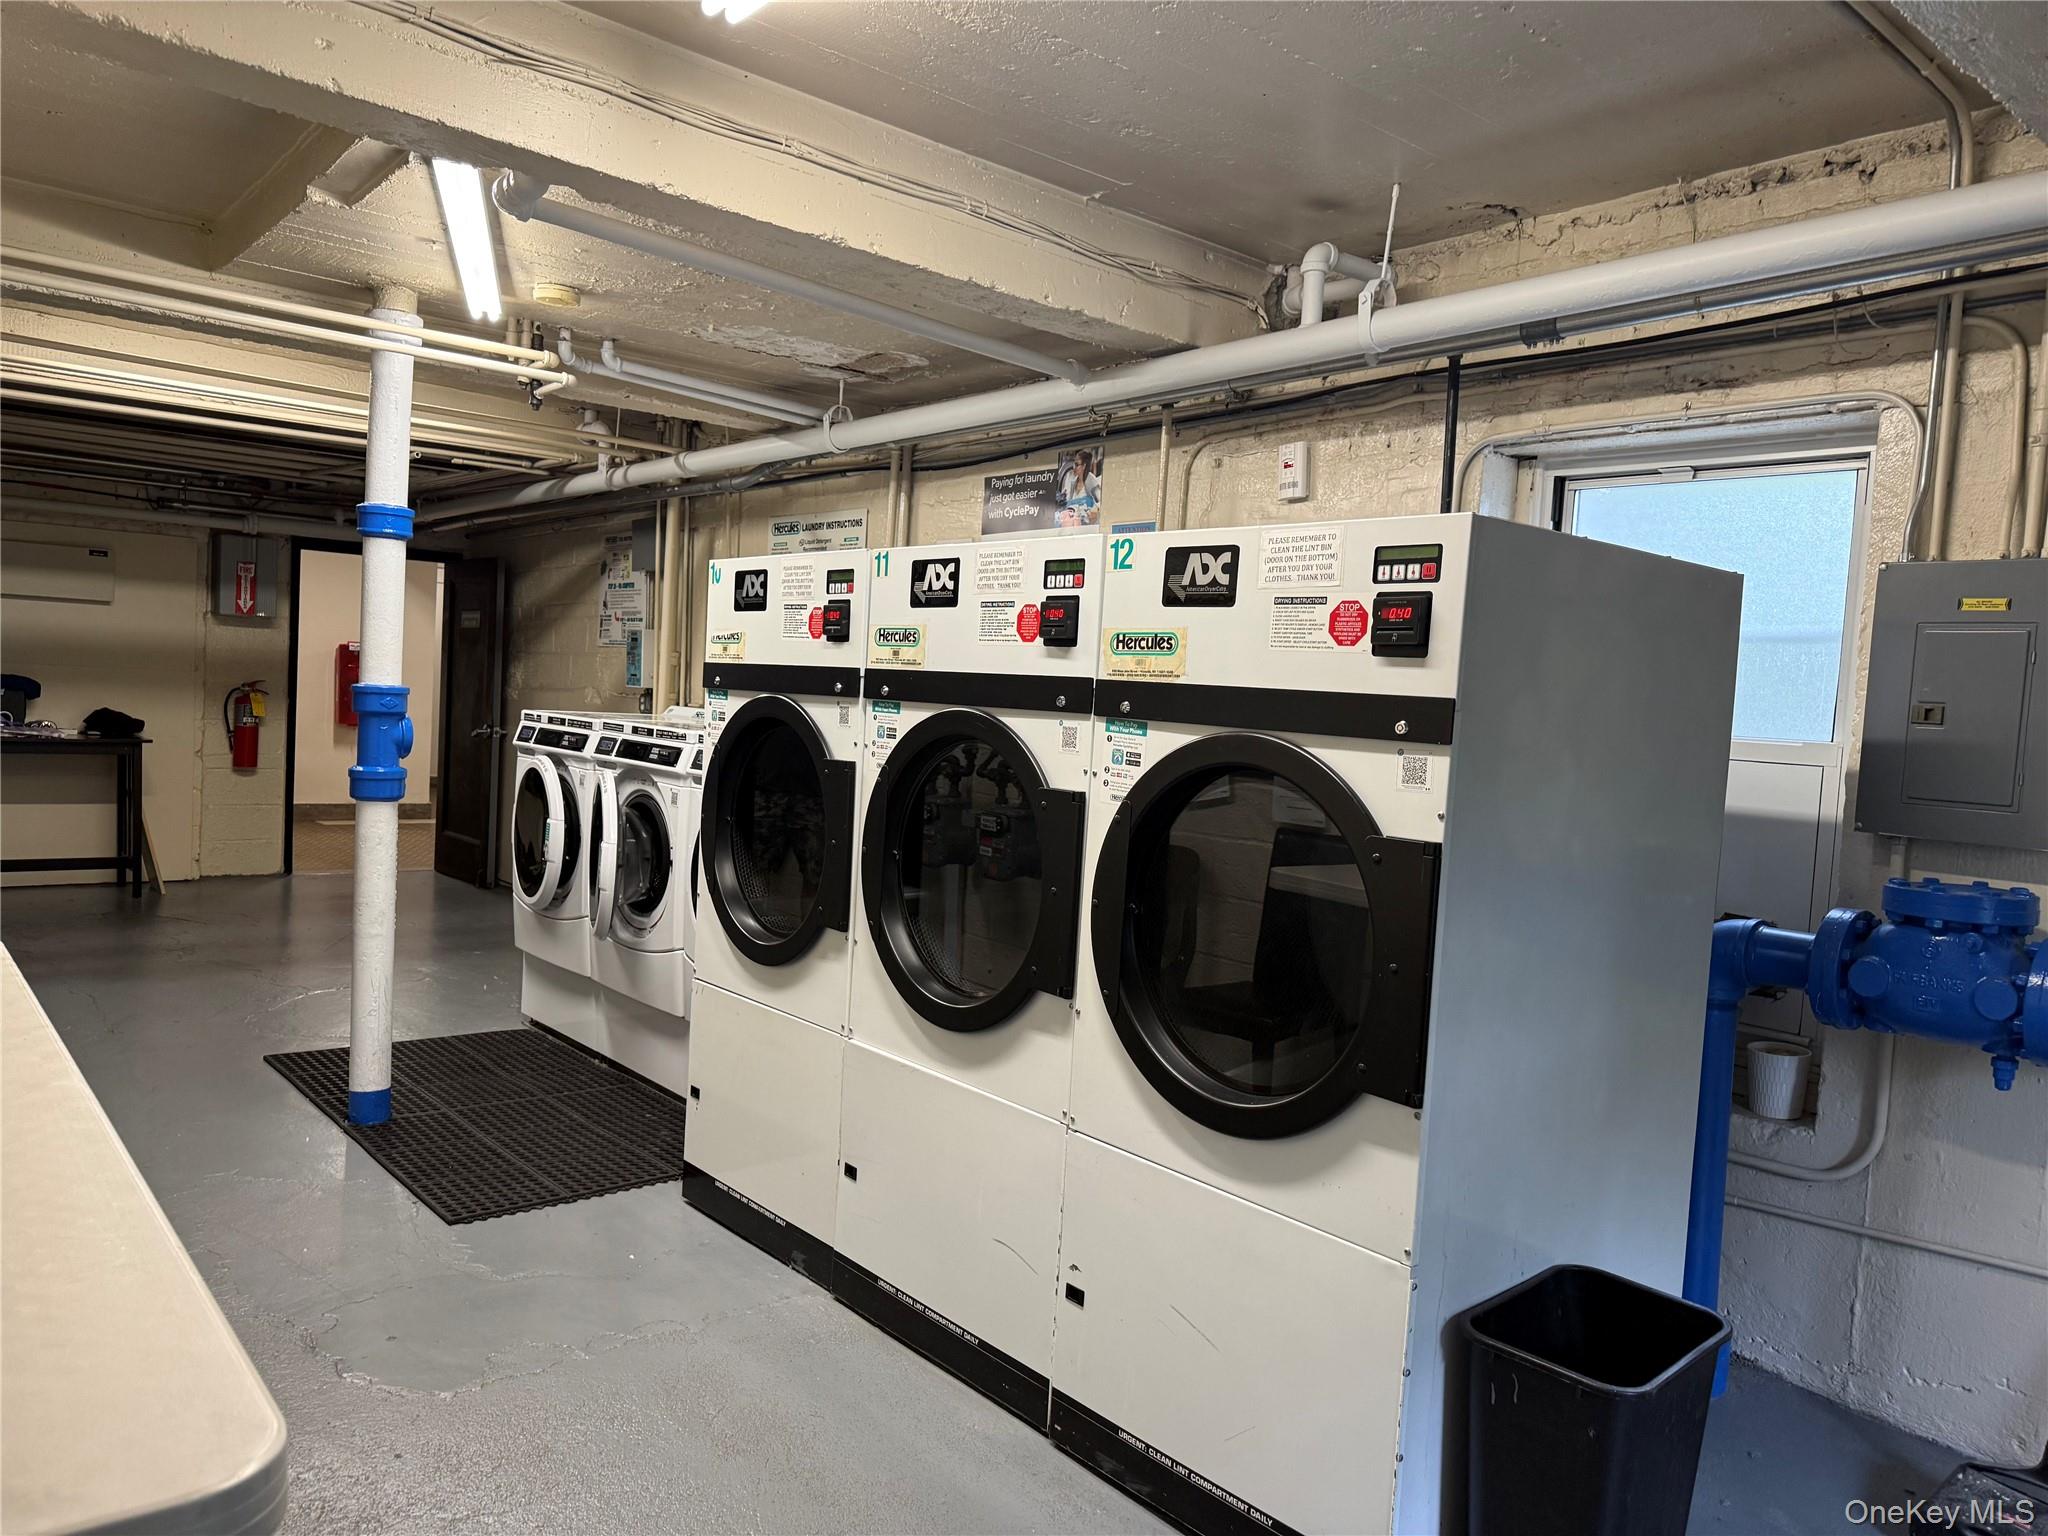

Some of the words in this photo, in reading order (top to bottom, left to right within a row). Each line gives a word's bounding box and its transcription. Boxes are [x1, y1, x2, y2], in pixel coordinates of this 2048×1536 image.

[992, 477, 1014, 490] Paying
[1014, 474, 1024, 484] for
[1025, 471, 1055, 483] laundry
[989, 494, 1002, 506] just
[1003, 492, 1014, 503] got
[1016, 488, 1038, 500] easier
[988, 508, 1003, 519] with
[1004, 505, 1039, 519] CyclePay
[774, 522, 799, 533] Hercules
[802, 522, 824, 532] LAUNDRY
[826, 518, 863, 529] INSTRUCTIONS
[1268, 536, 1290, 544] PLEASE
[1292, 534, 1326, 543] REMEMBER
[1110, 538, 1134, 570] 12
[1270, 546, 1290, 554] CLEAN
[1304, 544, 1320, 552] LINT
[875, 550, 888, 577] 11
[1264, 557, 1283, 565] (DOOR
[1309, 553, 1338, 561] BOTTOM)
[922, 562, 955, 590] ADC
[1182, 552, 1232, 585] ADC
[742, 574, 764, 597] ADC
[1389, 608, 1412, 618] 0.40
[878, 628, 916, 642] Hercules
[1116, 634, 1173, 650] Hercules
[898, 1292, 913, 1305] CLEAN
[925, 1308, 963, 1336] COMPARTMENT
[964, 1332, 978, 1345] DAILY
[1118, 1429, 1147, 1452] URGENT:
[1149, 1448, 1172, 1467] CLEAN
[1173, 1462, 1189, 1478] LINT
[1190, 1473, 1249, 1512] COMPARTMENT
[1250, 1508, 1273, 1527] DAILY
